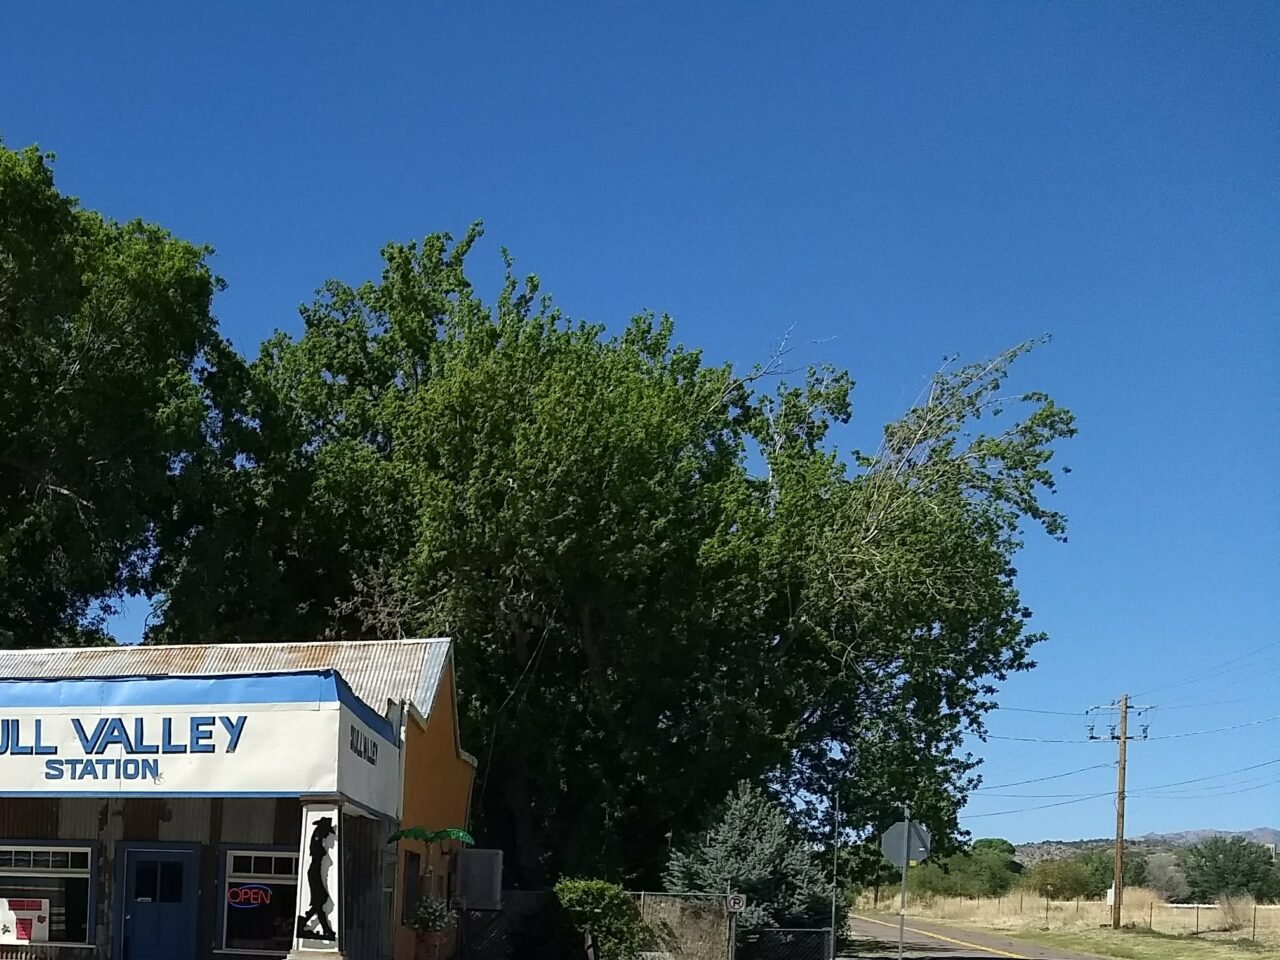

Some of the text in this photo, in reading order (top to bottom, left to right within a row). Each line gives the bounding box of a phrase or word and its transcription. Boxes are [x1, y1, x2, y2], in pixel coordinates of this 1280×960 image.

[71, 715, 248, 754] VALLEY
[45, 758, 159, 780] STATION
[228, 888, 271, 904] OPEN
